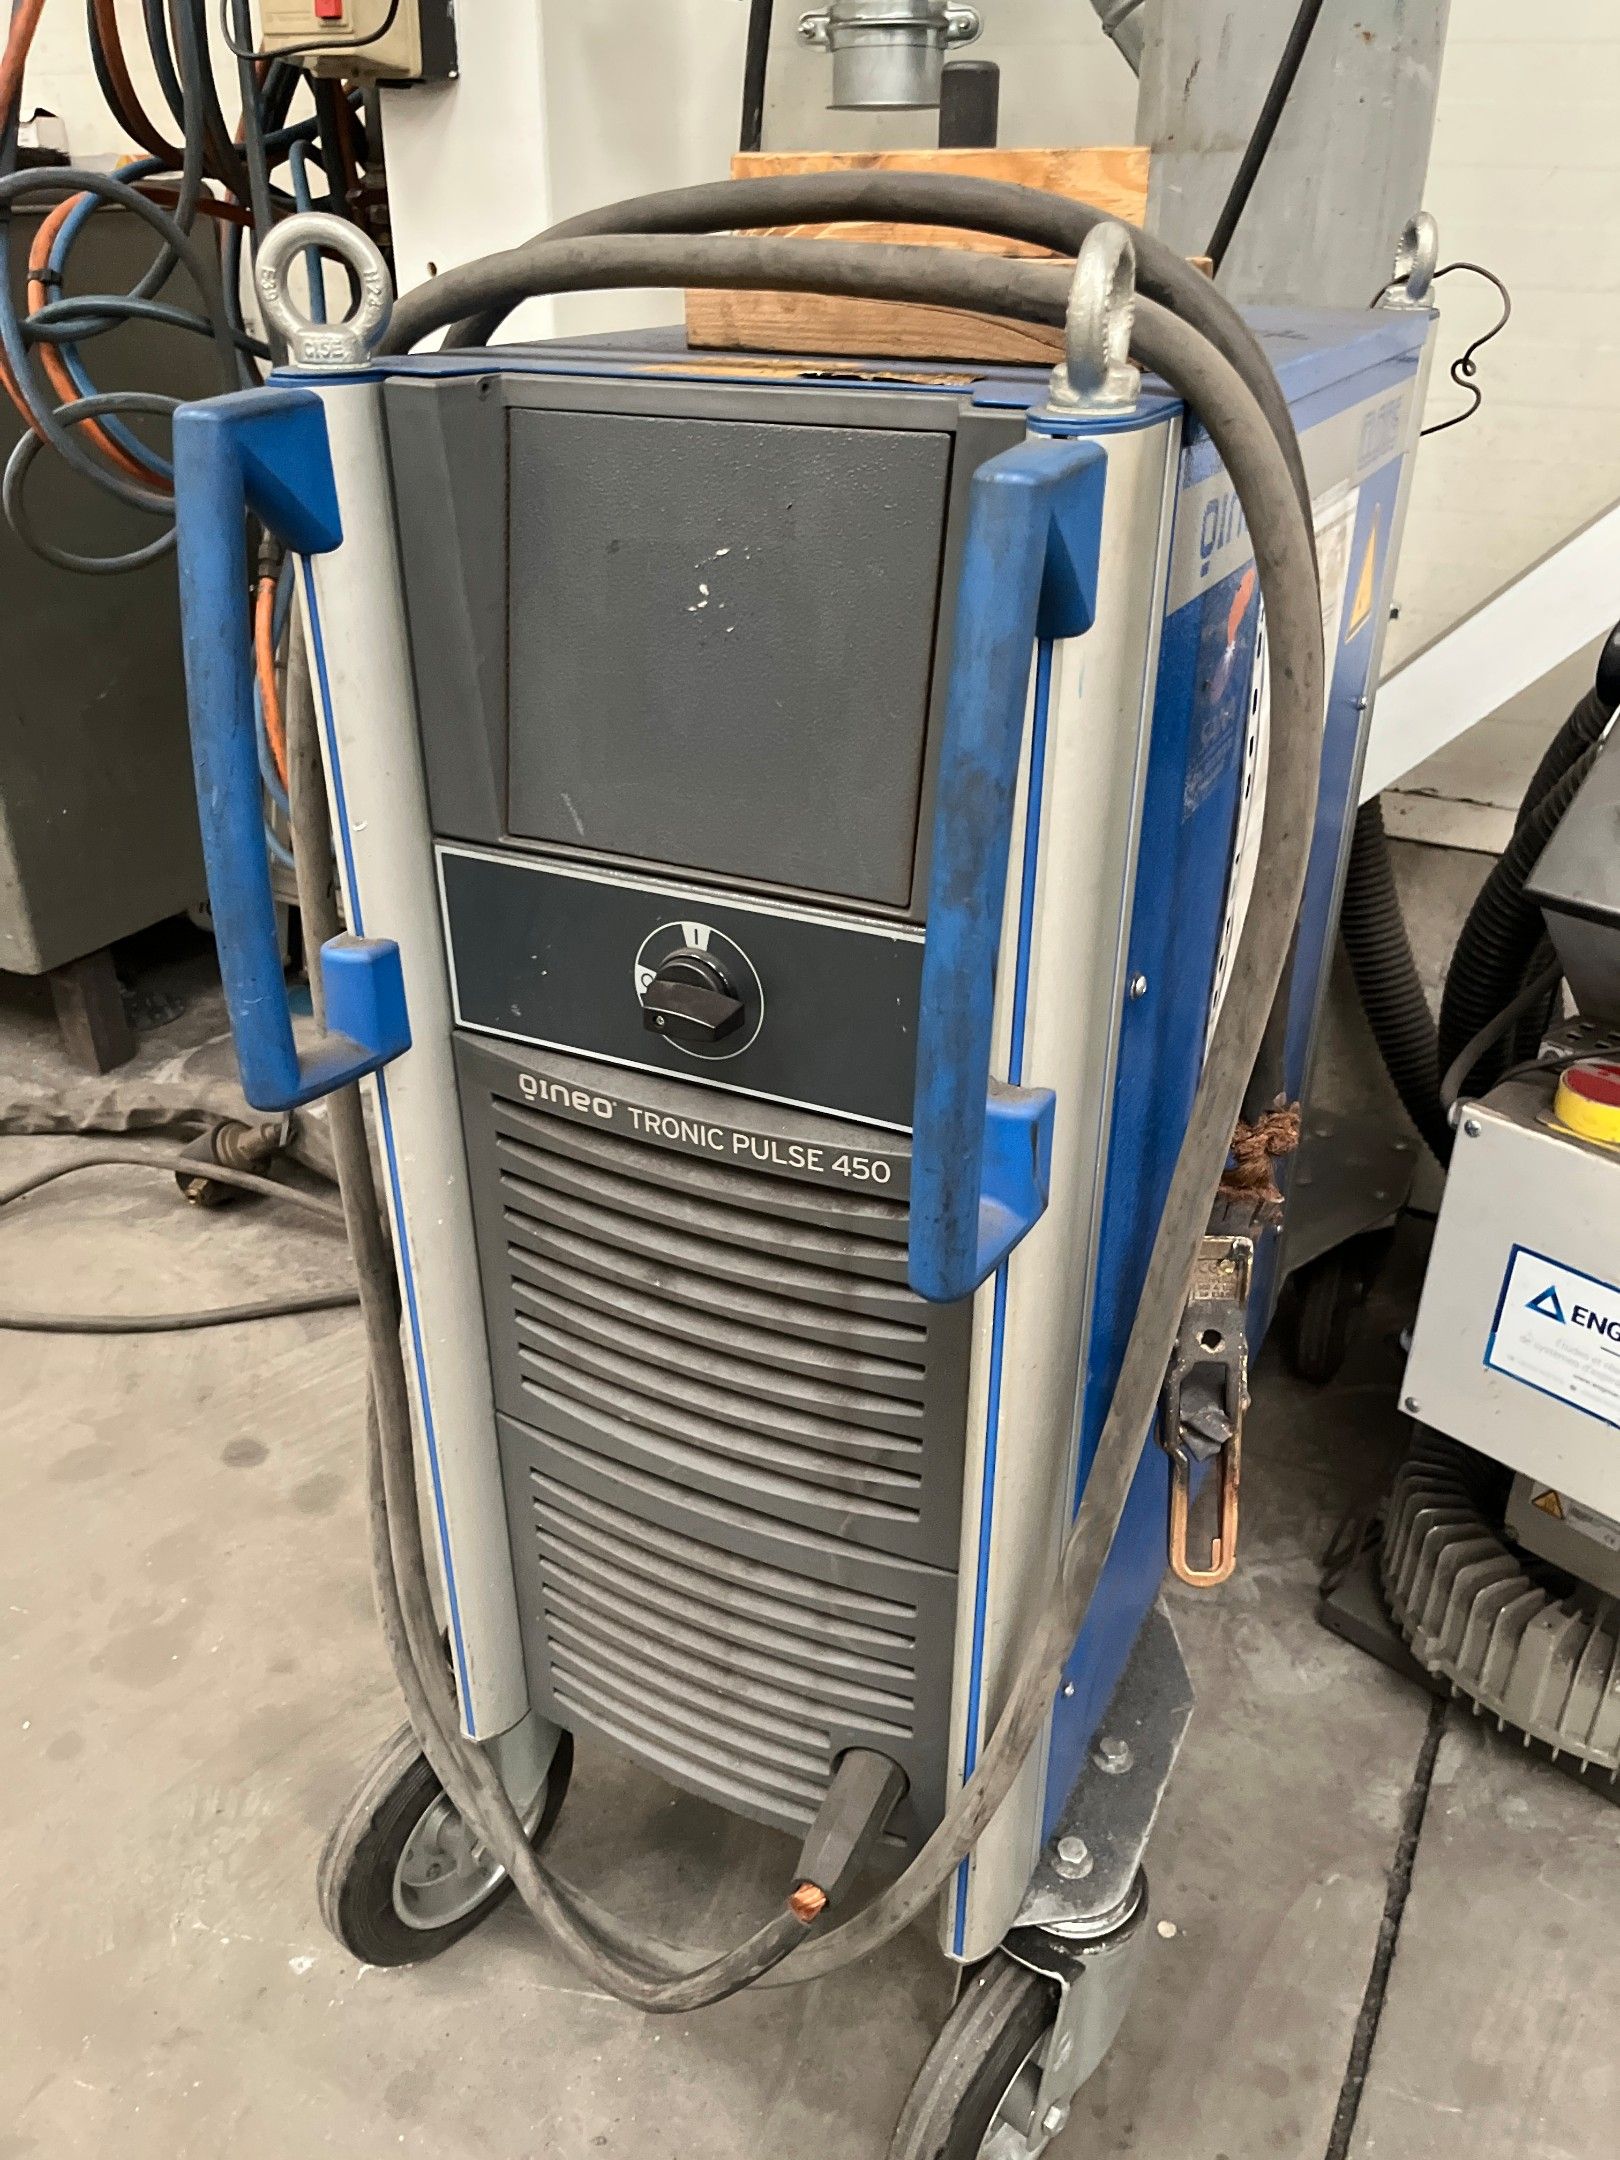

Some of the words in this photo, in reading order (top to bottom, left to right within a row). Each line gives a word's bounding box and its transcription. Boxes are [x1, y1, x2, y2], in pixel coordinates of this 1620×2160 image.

[627, 1106, 725, 1152] TRONIC
[732, 1132, 825, 1172] PULSE
[831, 1154, 891, 1184] 450
